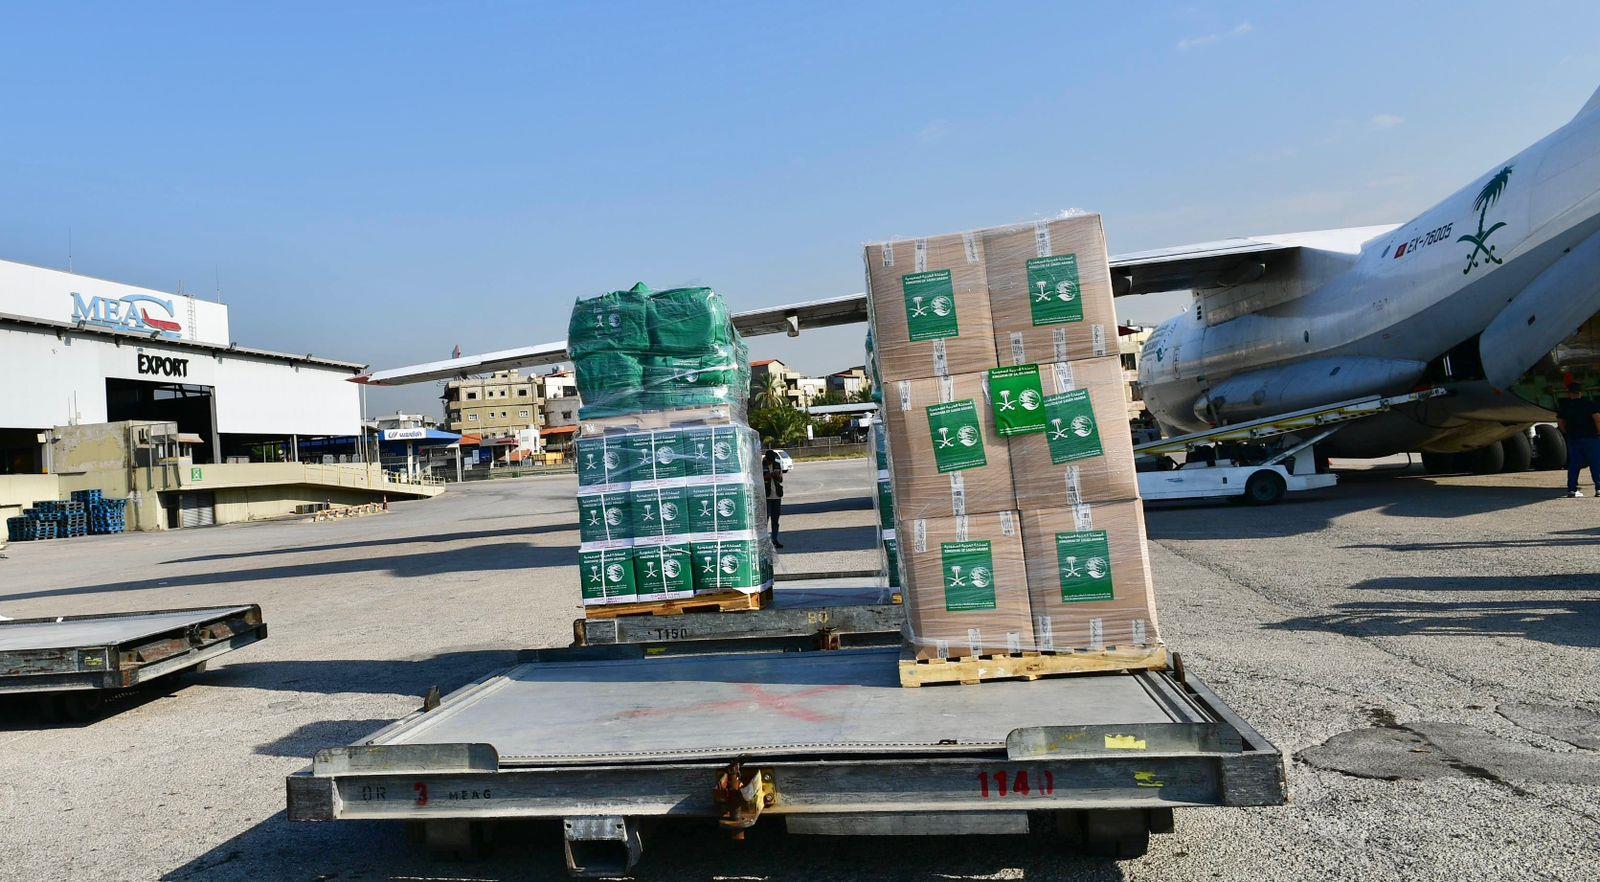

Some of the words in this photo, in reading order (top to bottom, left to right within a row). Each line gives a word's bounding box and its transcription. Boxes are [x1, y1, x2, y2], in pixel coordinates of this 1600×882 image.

[1407, 222, 1454, 254] EX-76005
[137, 353, 189, 377] EXPORT
[413, 782, 429, 808] 3
[448, 789, 492, 801] MEAG
